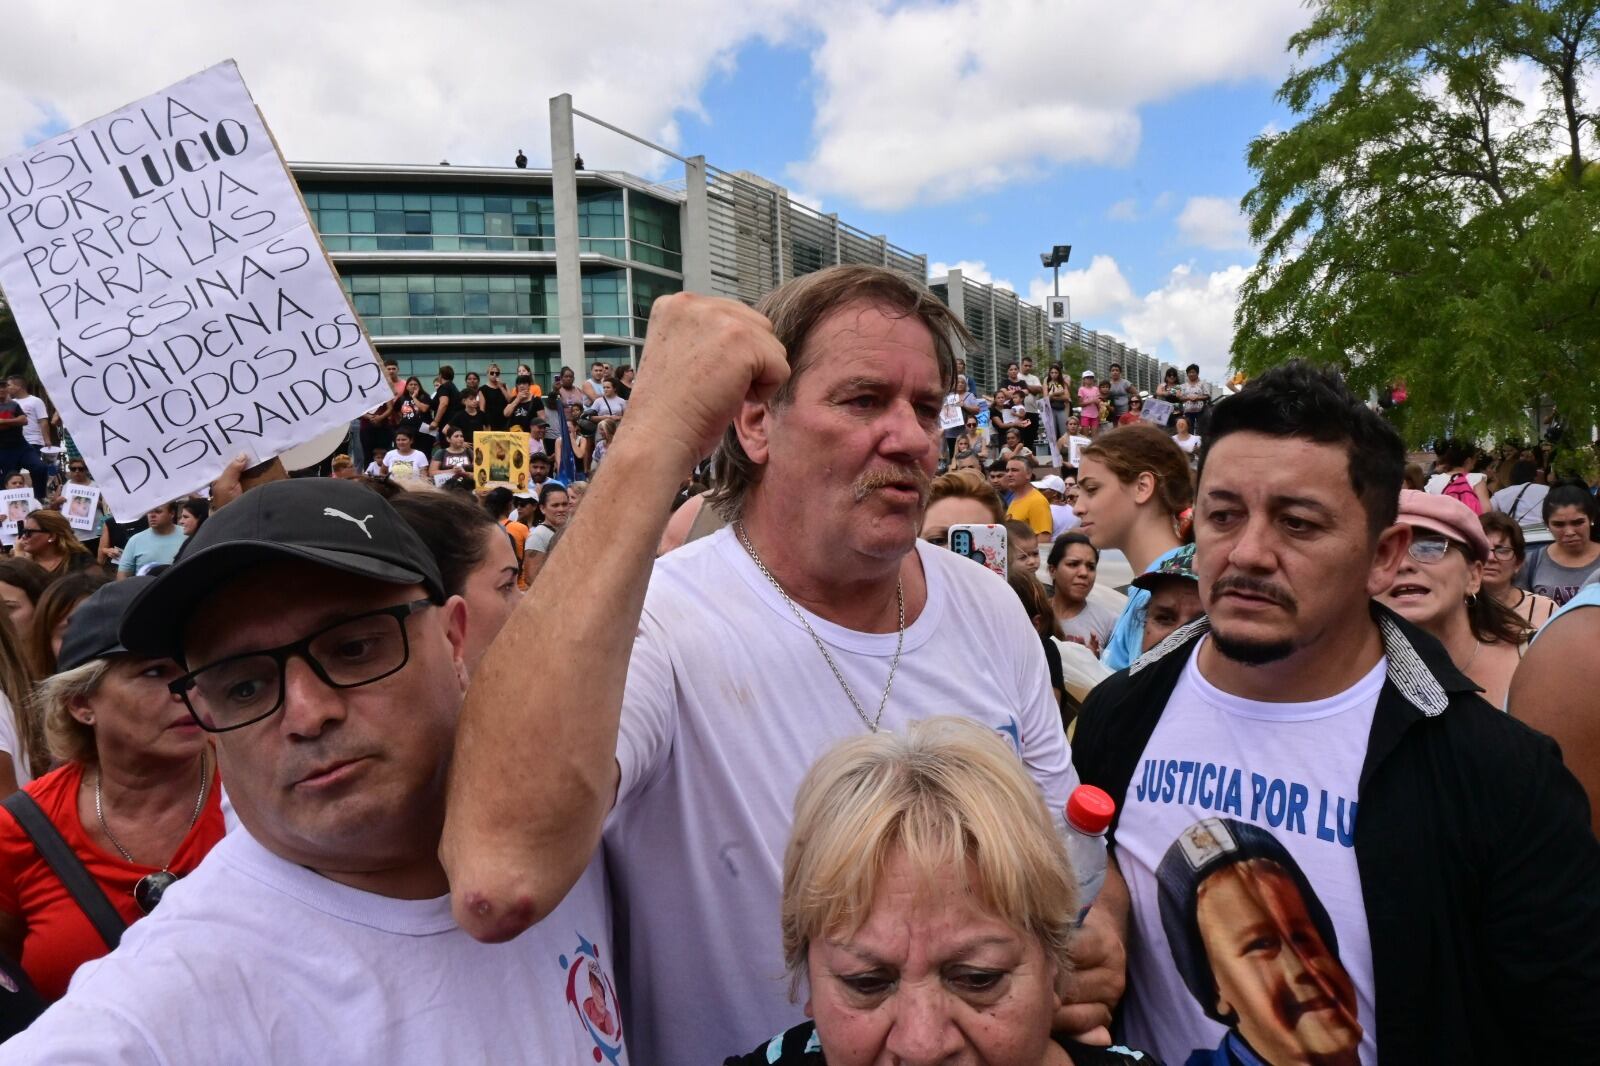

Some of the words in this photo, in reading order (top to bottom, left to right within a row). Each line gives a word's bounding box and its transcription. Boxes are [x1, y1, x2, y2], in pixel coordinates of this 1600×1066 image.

[0, 97, 208, 210] JUSTICIA
[8, 180, 110, 243] POR
[118, 118, 249, 199] LUCIO
[23, 171, 258, 288] PERPETUA
[40, 253, 172, 330] PARA
[177, 205, 276, 266] LAS
[57, 238, 310, 378] ASESINAS
[71, 287, 315, 417] CONDENA
[100, 419, 131, 456] A
[128, 345, 297, 434] TODOS
[301, 313, 361, 356] LOS
[111, 355, 381, 494] DISTRAIDOS
[1136, 759, 1242, 817] JUSTICIA
[1251, 773, 1309, 835] POR
[1316, 789, 1358, 848] LU
